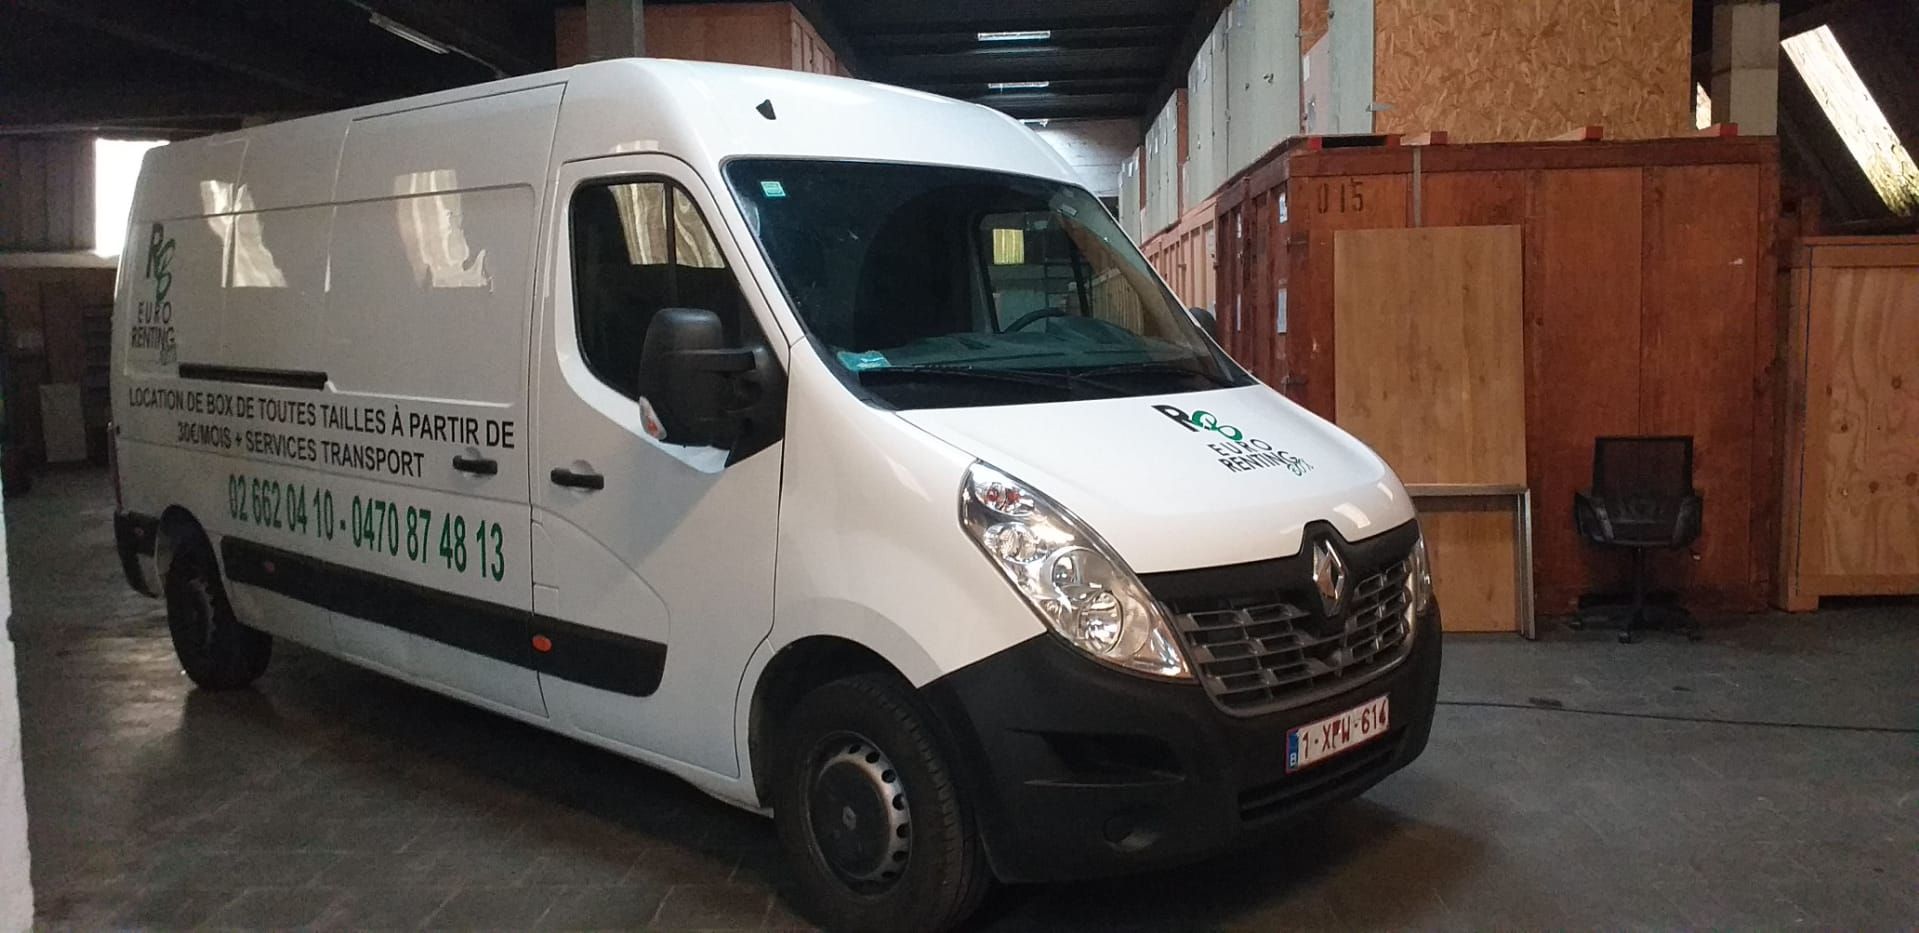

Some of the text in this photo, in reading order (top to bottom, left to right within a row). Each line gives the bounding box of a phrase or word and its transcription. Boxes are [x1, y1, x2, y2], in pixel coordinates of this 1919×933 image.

[1318, 178, 1364, 214] 015
[138, 301, 172, 324] EURO
[131, 327, 176, 349] RENTING
[129, 387, 515, 449] LOCATION DE BOX DE TOUTES TAILLES À PARTIR DE
[177, 421, 425, 478] 30€/MOIS + SERVICES TRANSPORT
[1208, 439, 1273, 456] EURO
[1218, 451, 1298, 473] RENTING
[228, 474, 248, 521] 02
[252, 478, 282, 528] 662
[286, 483, 308, 534] 04
[313, 488, 334, 540] 10
[352, 496, 399, 557] 0470
[406, 506, 432, 564] 87
[439, 512, 467, 573] 48
[476, 520, 505, 581] 13
